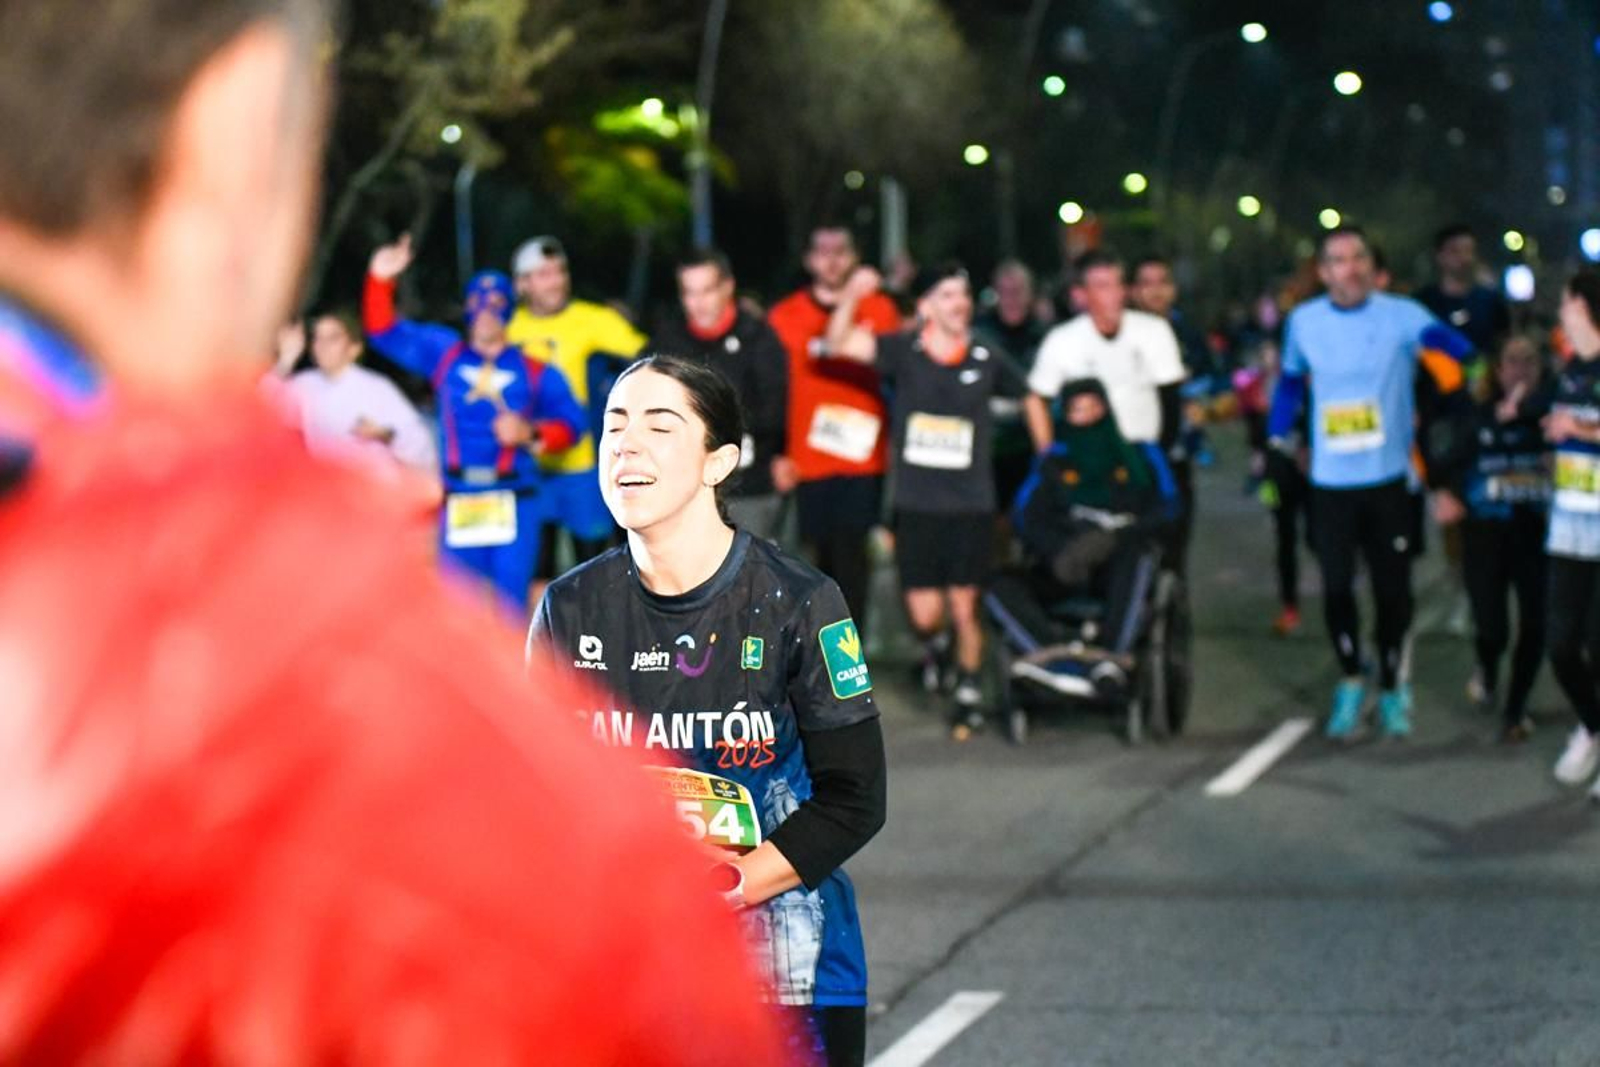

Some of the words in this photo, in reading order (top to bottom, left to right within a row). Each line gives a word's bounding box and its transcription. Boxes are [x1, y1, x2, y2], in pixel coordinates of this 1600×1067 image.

[576, 709, 634, 747] AN
[645, 701, 776, 749] ANTÓN
[715, 737, 777, 769] 2025
